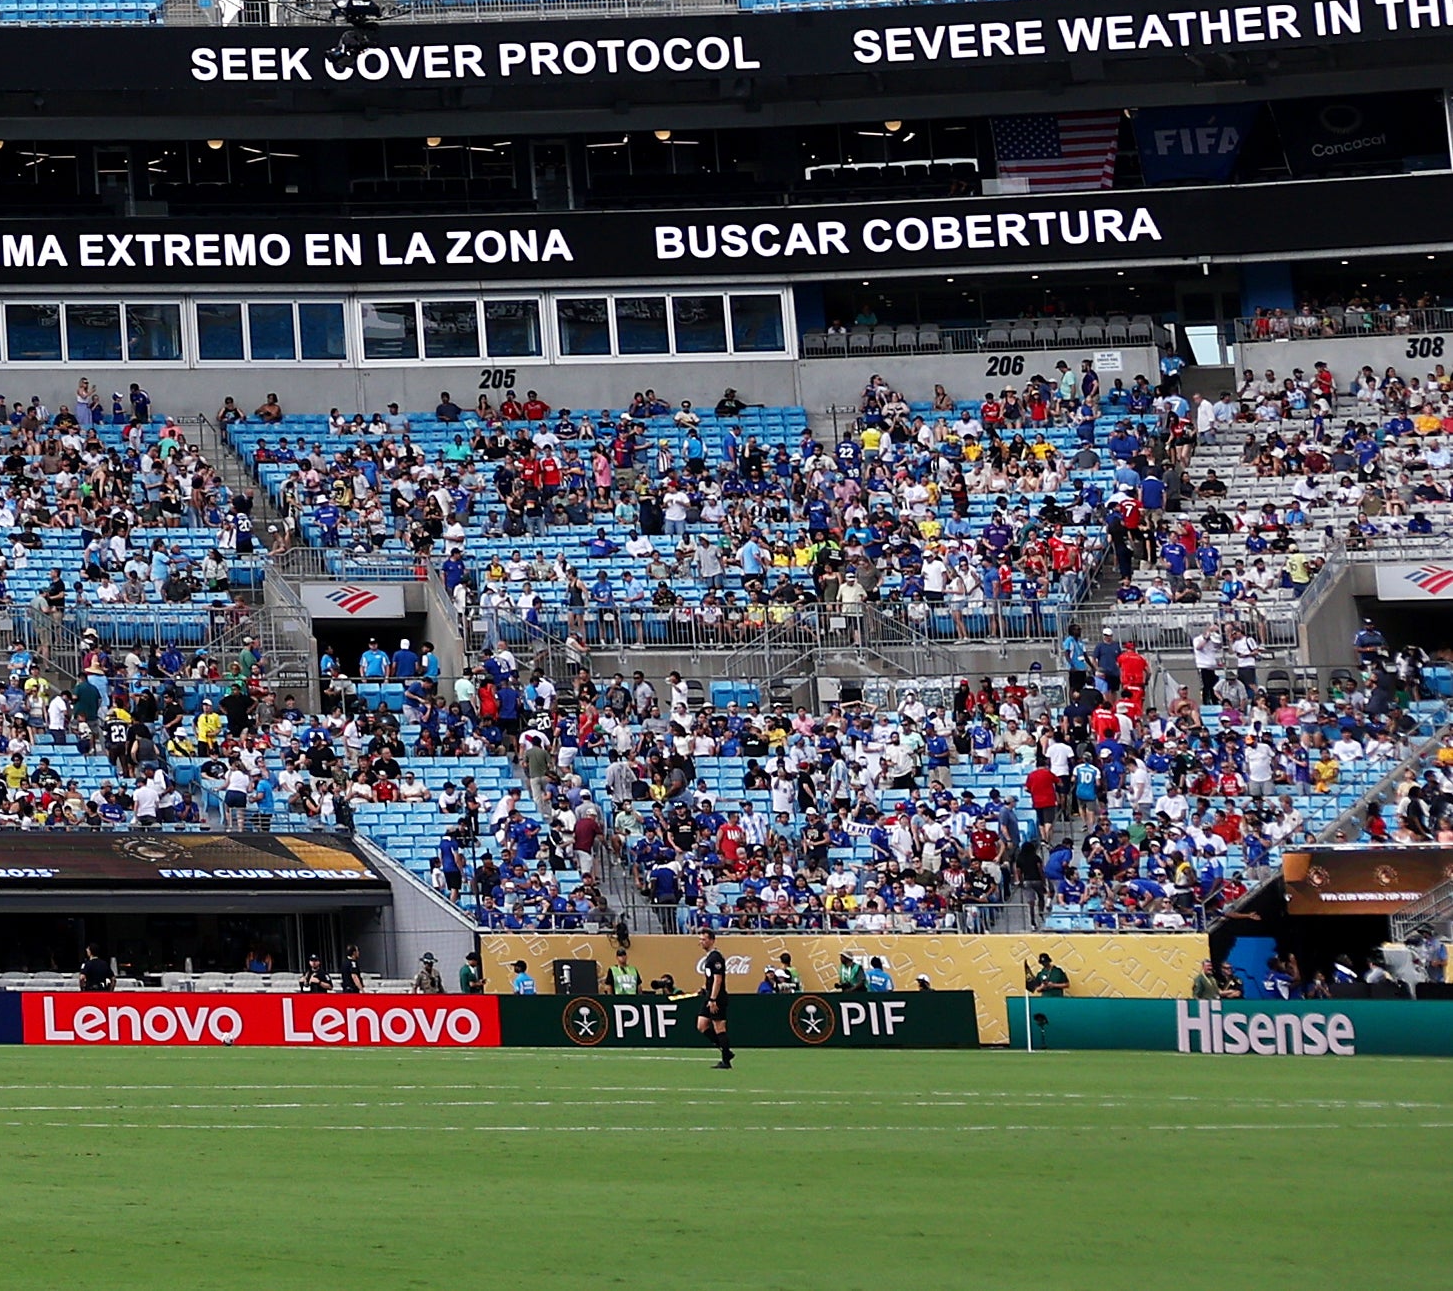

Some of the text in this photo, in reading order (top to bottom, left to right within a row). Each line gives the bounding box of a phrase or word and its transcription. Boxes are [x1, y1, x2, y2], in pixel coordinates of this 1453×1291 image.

[854, 21, 1045, 63] SEVERE
[1058, 5, 1301, 52] WEATHER
[1315, 0, 1360, 35] IN
[192, 37, 760, 80] SEEK COVER PROTOCOL
[1154, 127, 1240, 155] FIFA
[80, 234, 290, 266] EXTREMO
[305, 234, 361, 265] EN
[378, 232, 436, 265] LA
[447, 229, 573, 263] ZONA
[656, 208, 1161, 258] BUSCAR COBERTURA
[1406, 337, 1444, 358] 308
[479, 368, 516, 390] 205
[985, 355, 1024, 377] 206
[1125, 506, 1133, 517] 7
[111, 725, 127, 742] 23
[537, 716, 552, 730] 20
[43, 996, 243, 1042] Lenovo
[283, 997, 481, 1043] Lenovo
[616, 1002, 678, 1037] PIF
[841, 1001, 906, 1036] PIF
[1176, 999, 1356, 1056] Hisense
